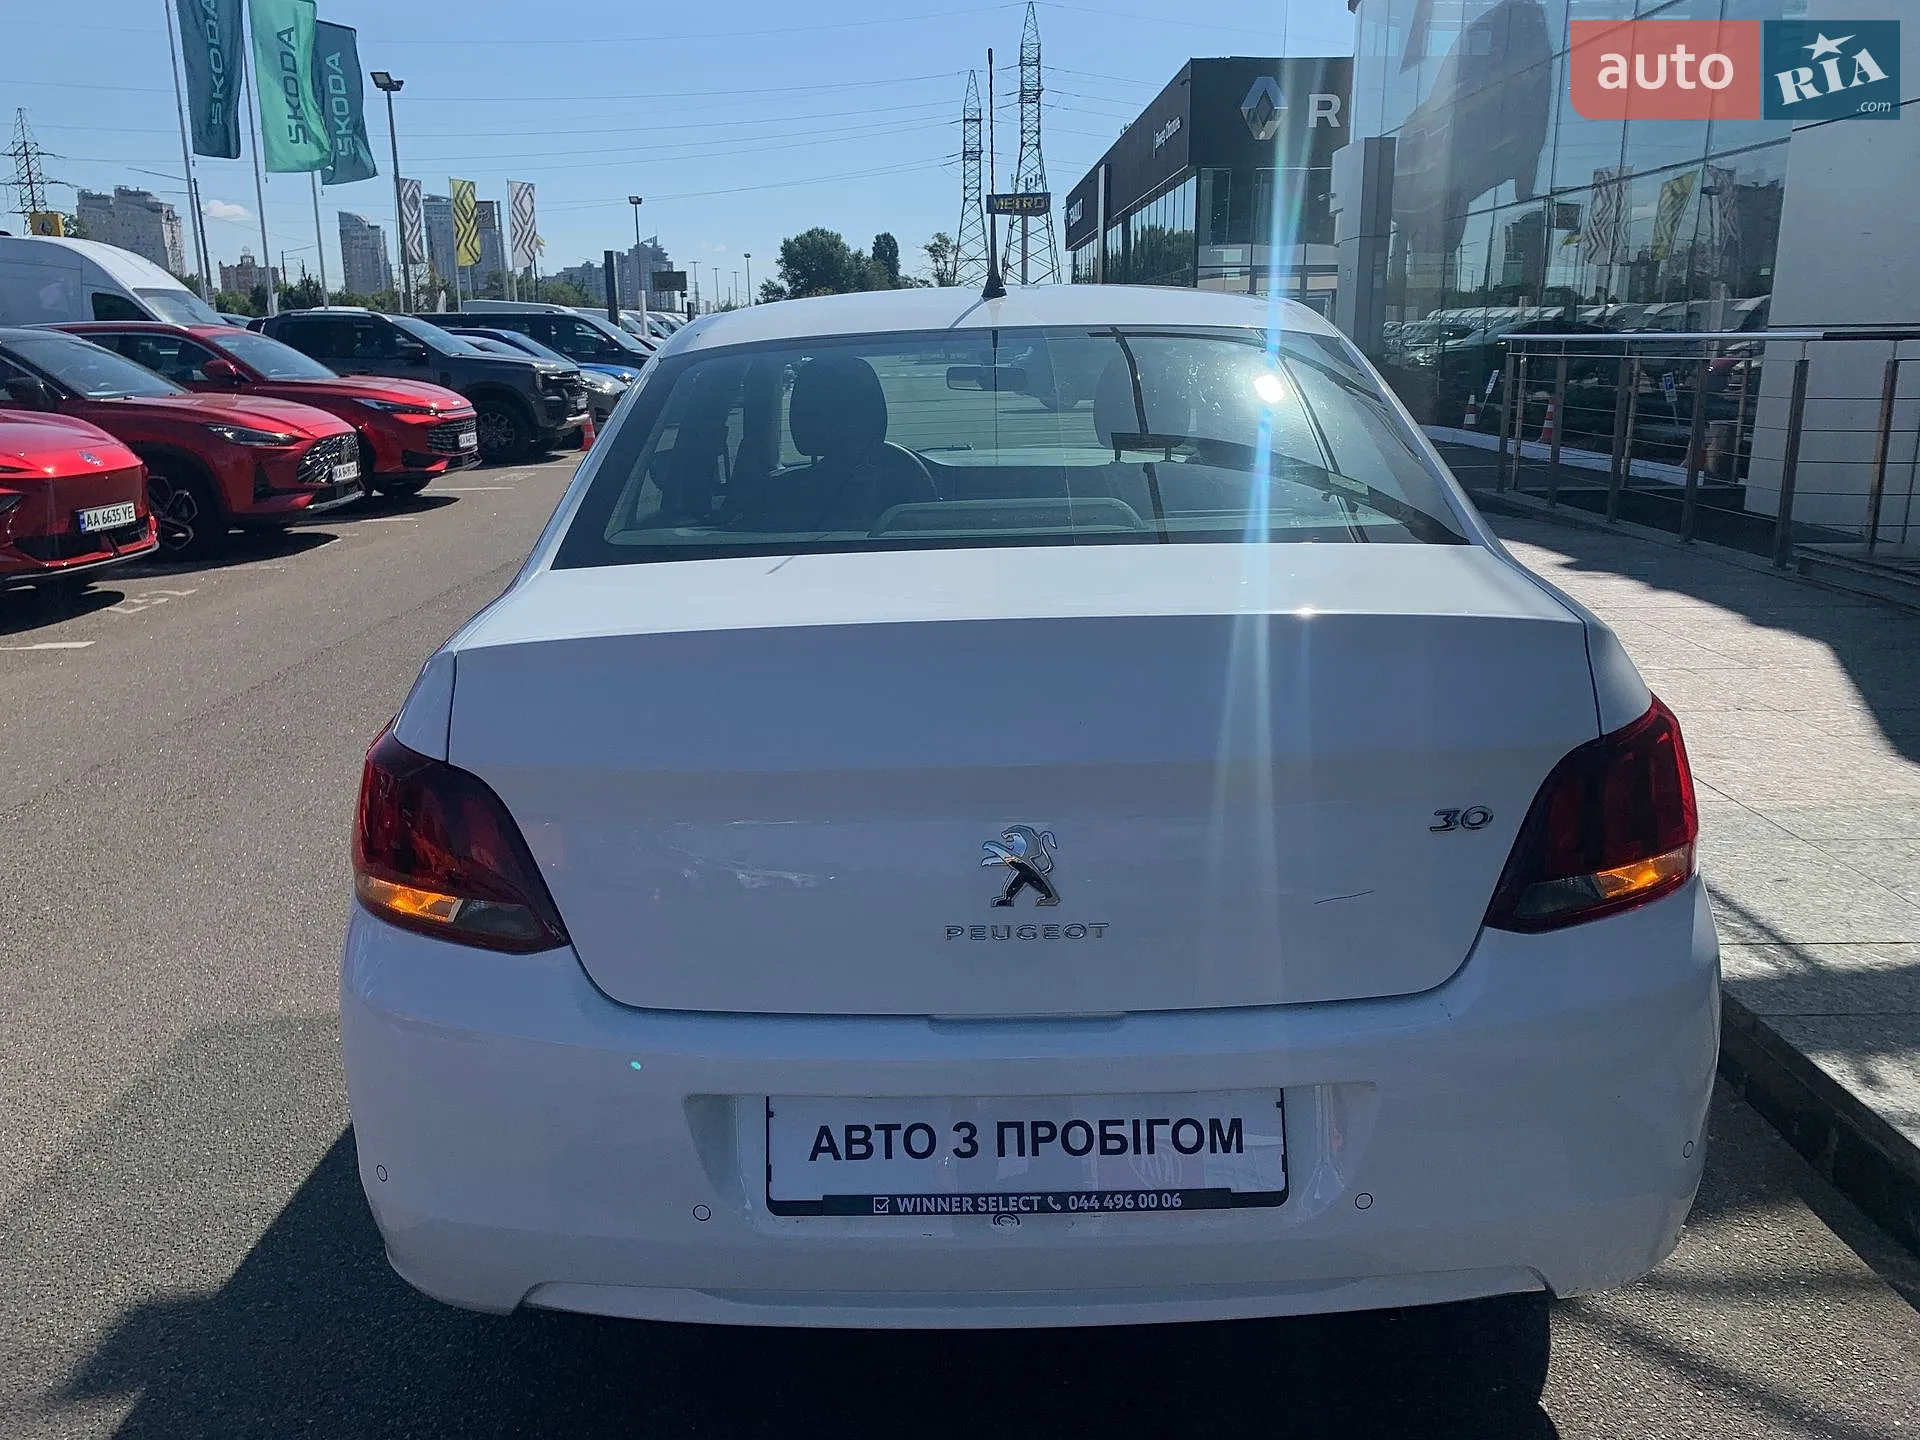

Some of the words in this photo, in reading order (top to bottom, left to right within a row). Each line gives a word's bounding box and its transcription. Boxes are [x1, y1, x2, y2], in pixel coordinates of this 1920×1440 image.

[1308, 93, 1351, 128] R
[992, 196, 1045, 210] METRO
[87, 512, 100, 527] AA
[102, 508, 121, 524] 6635
[1429, 805, 1494, 832] 30
[944, 922, 1109, 941] PEUGEOT
[808, 1122, 937, 1161] АВТО
[997, 1117, 1244, 1158] ПРОБІГОМ
[896, 1197, 975, 1213] WINNER
[978, 1195, 1042, 1212] SELECT
[1068, 1194, 1100, 1211] 044
[1103, 1193, 1134, 1209] 496
[1138, 1193, 1158, 1208] 00
[1161, 1192, 1182, 1208] 06
